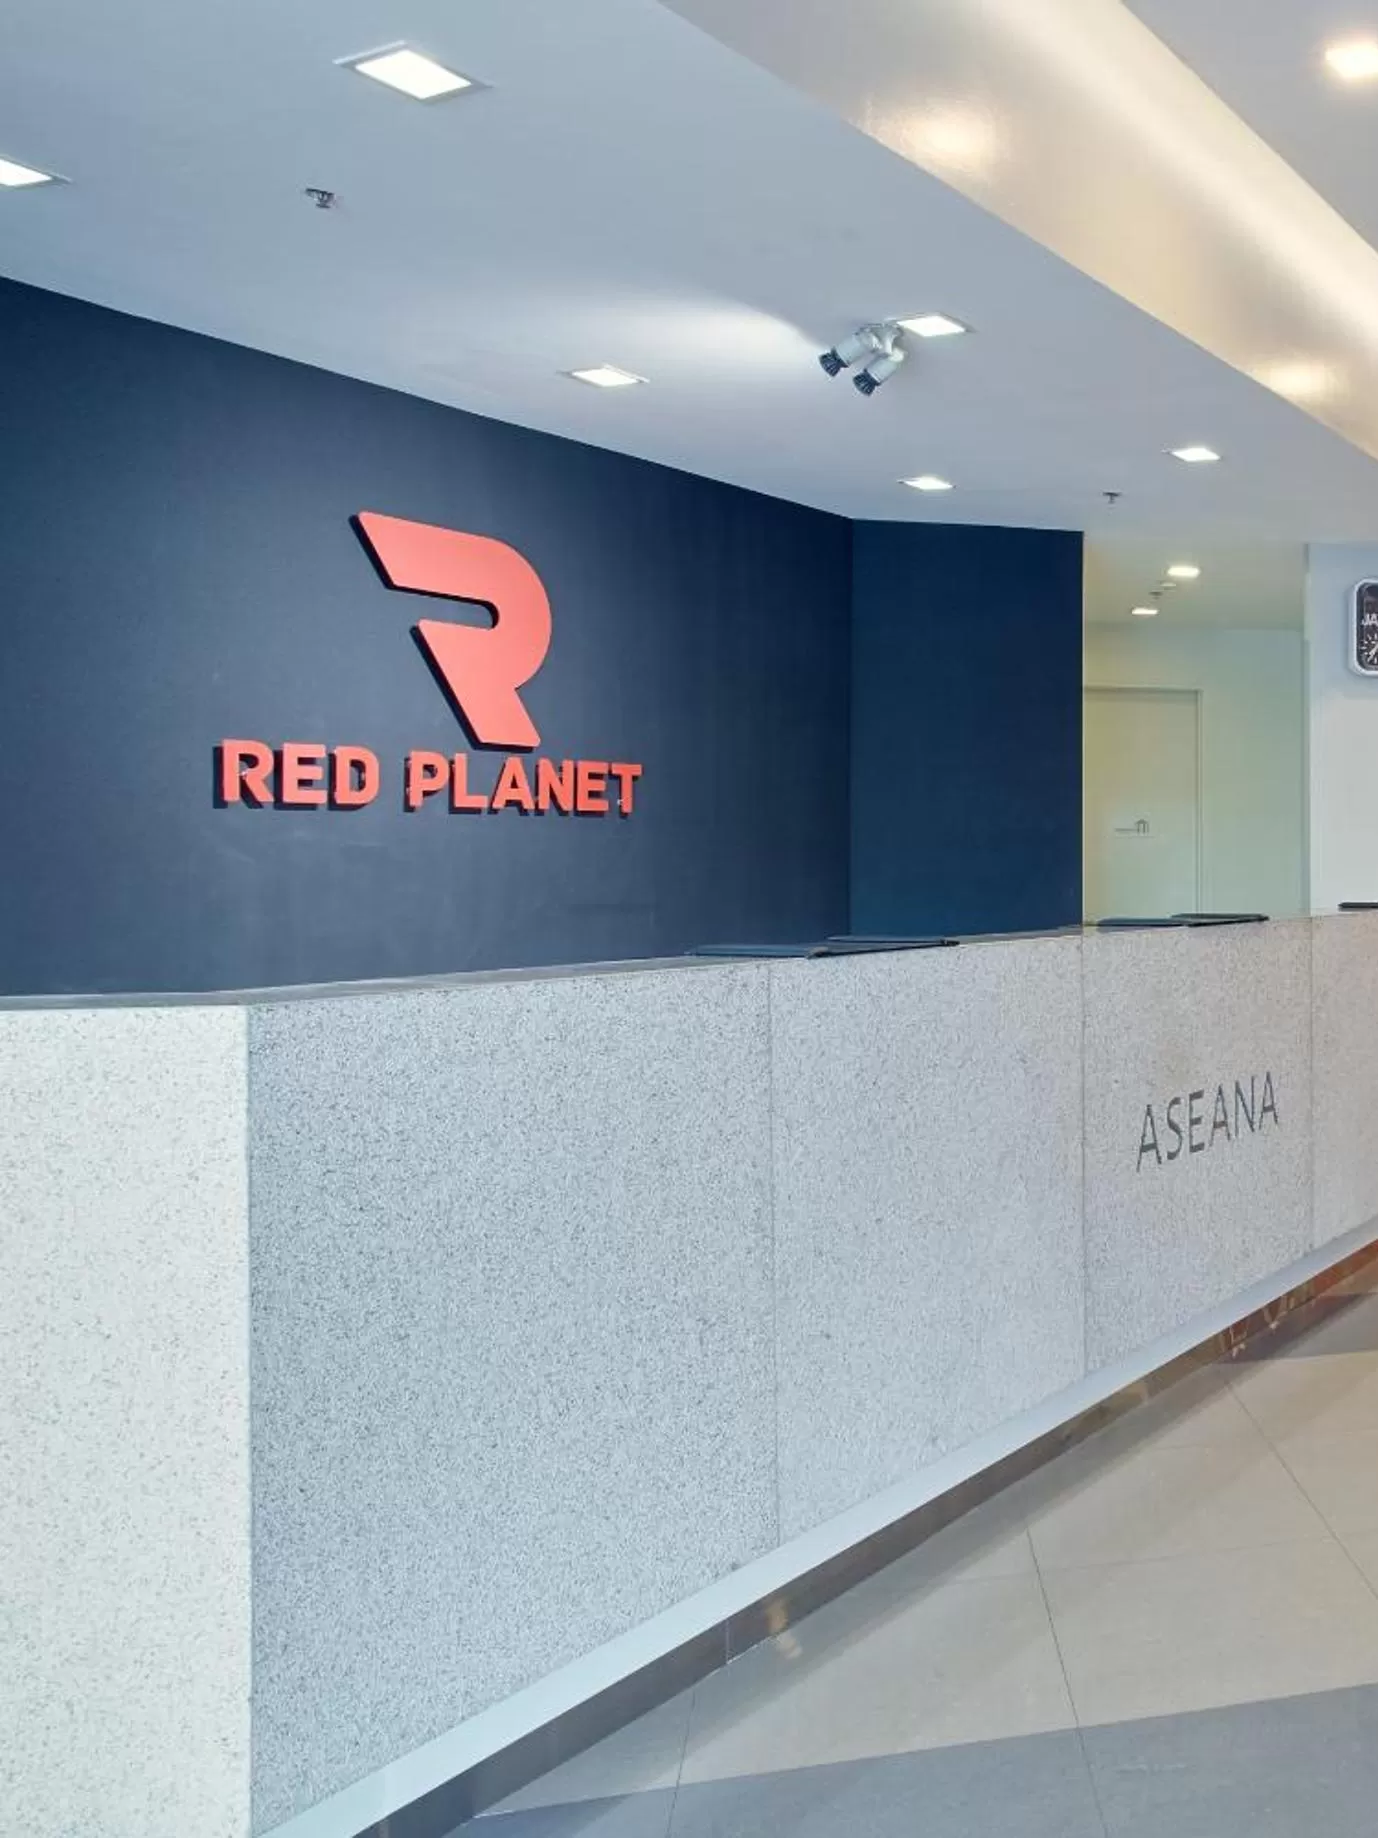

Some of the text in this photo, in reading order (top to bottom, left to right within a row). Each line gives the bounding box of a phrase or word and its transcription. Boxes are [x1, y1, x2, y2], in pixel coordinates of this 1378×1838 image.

[217, 738, 643, 814] RED PLANET
[1136, 1071, 1278, 1172] ASEANA
